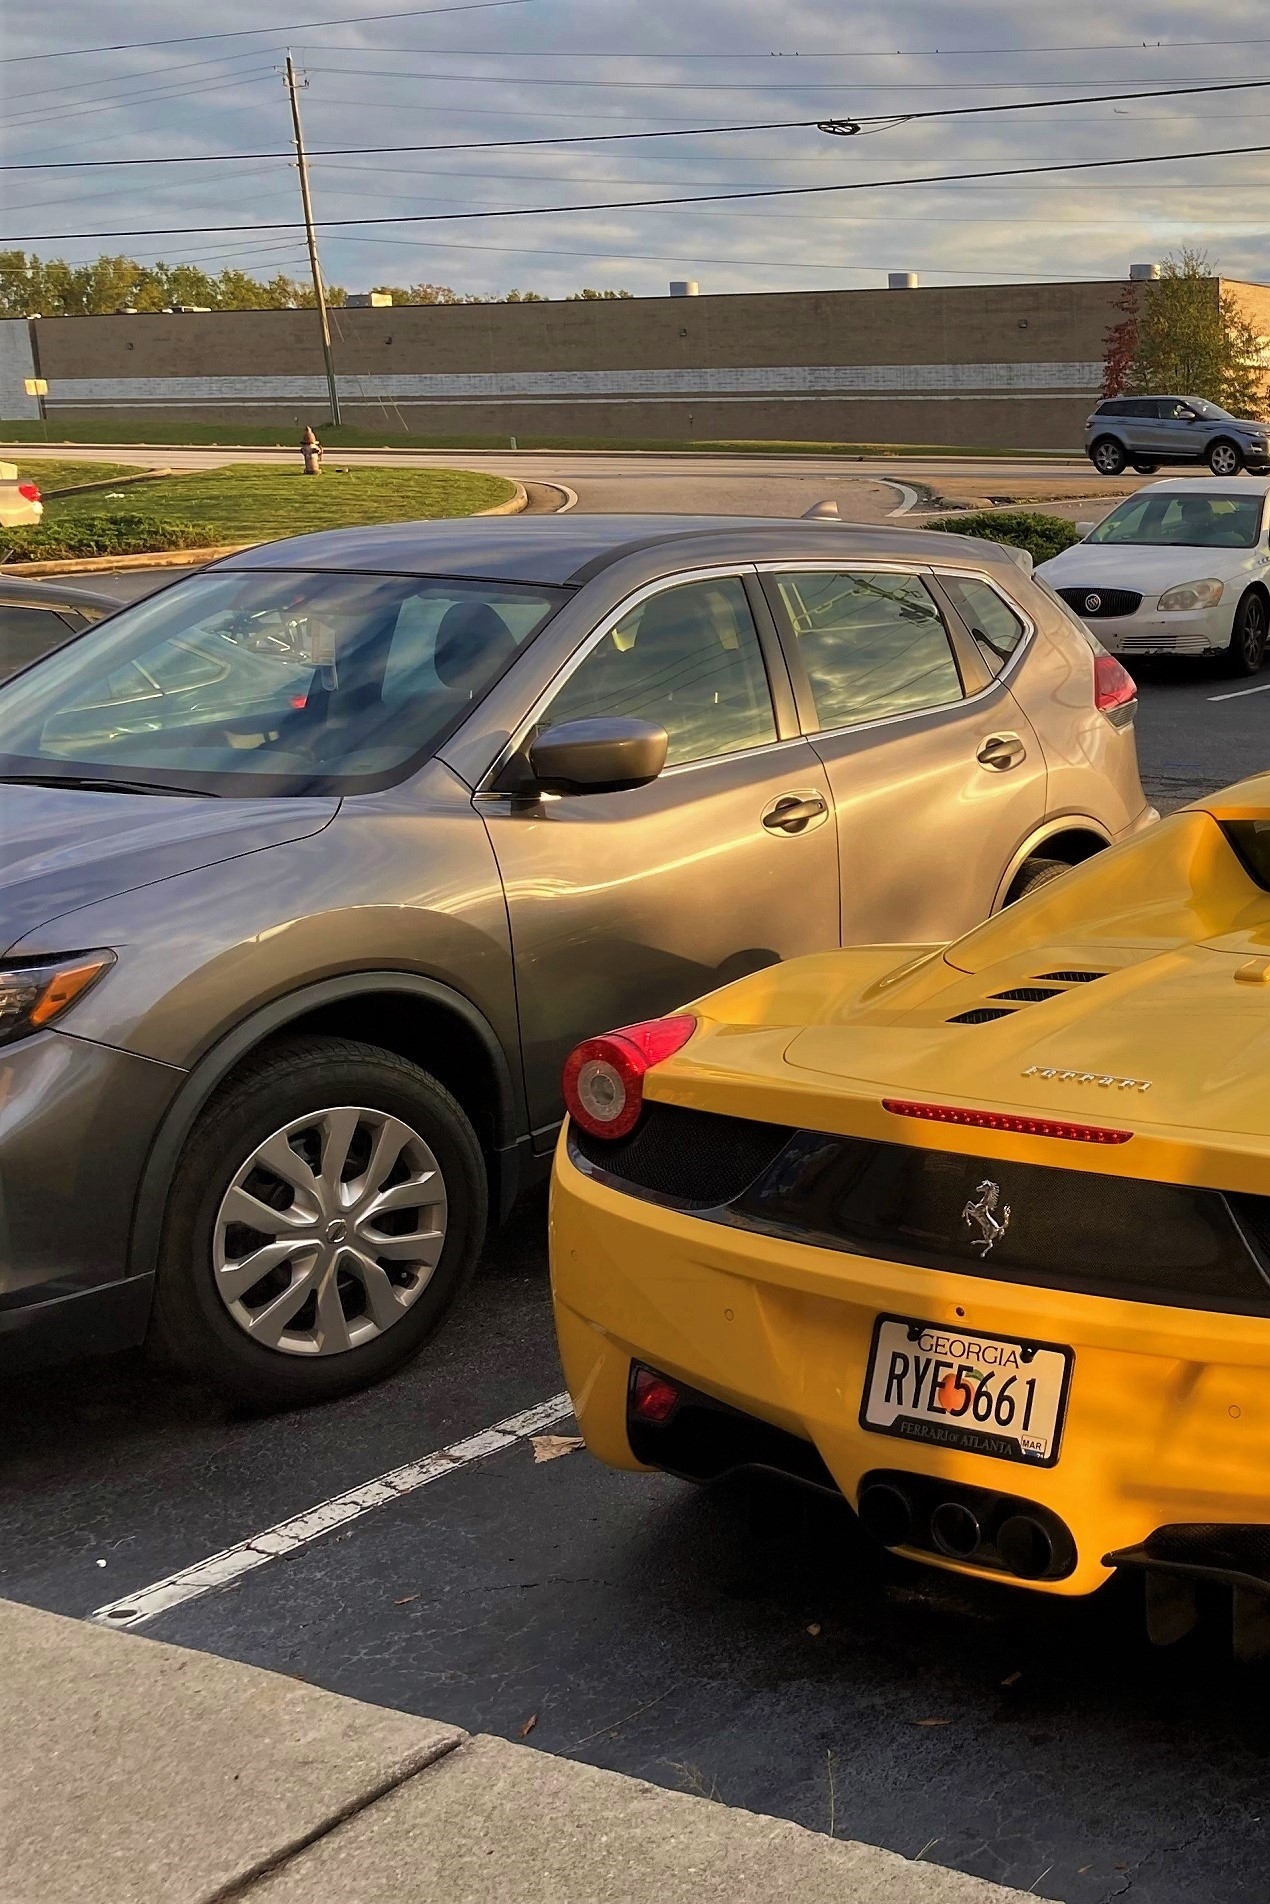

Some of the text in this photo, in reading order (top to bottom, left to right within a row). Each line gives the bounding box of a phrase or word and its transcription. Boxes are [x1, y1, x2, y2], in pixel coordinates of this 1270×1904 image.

[918, 1334, 1020, 1369] GEORGIA
[884, 1351, 1037, 1431] RYE5661
[901, 1421, 949, 1441] FERRARI
[961, 1434, 1013, 1455] ATLANTA
[1022, 1439, 1042, 1451] MAR
